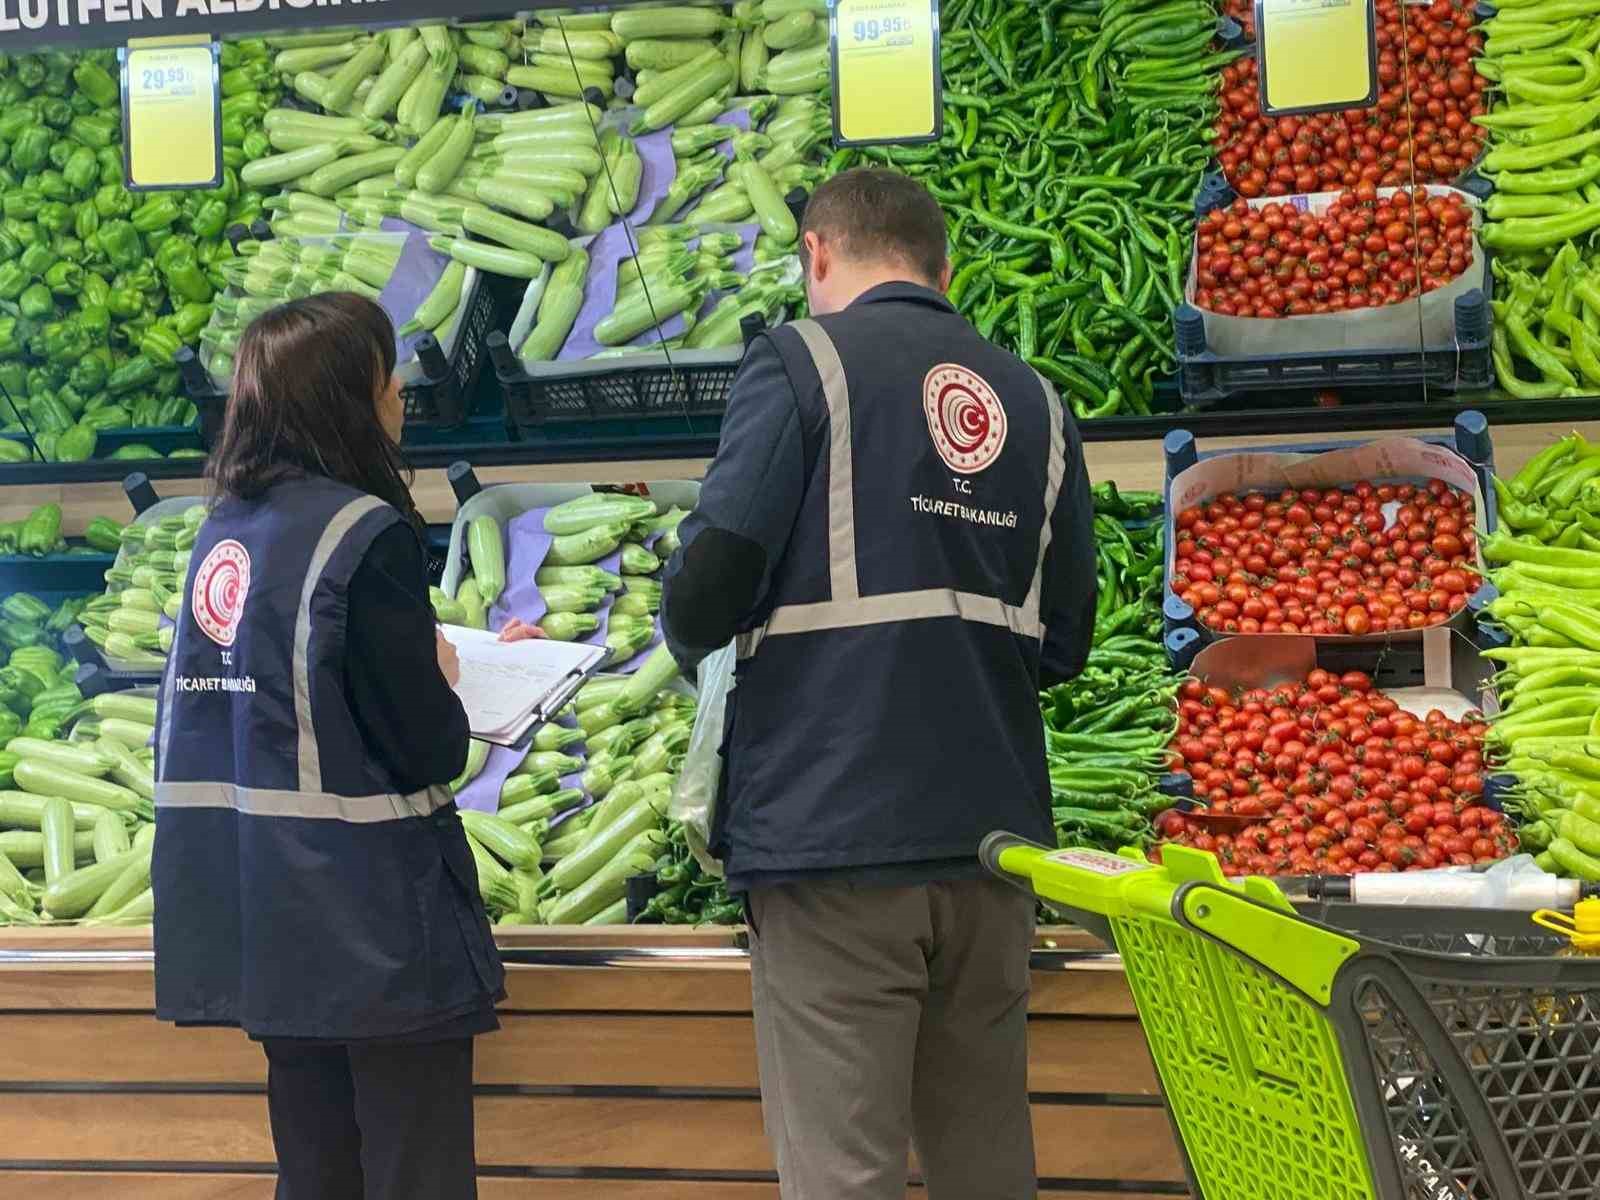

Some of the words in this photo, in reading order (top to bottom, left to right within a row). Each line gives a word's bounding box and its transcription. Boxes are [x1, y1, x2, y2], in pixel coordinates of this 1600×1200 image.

[953, 478, 972, 494] T.C.
[910, 494, 960, 517] TİCARET
[960, 505, 1018, 528] BAKANLIĞI
